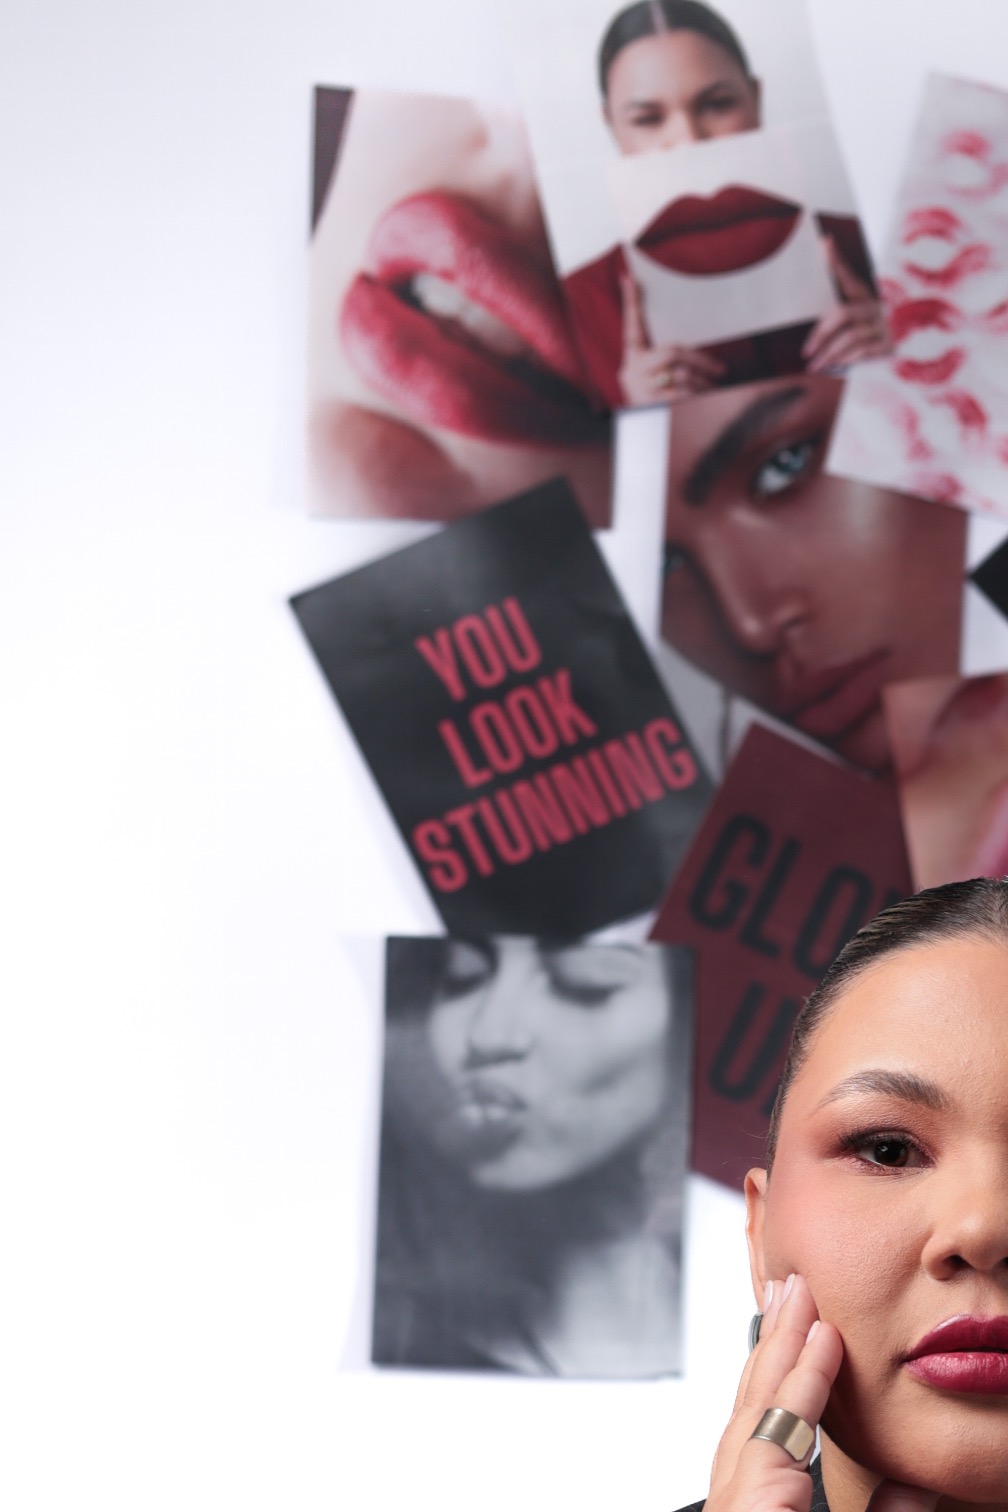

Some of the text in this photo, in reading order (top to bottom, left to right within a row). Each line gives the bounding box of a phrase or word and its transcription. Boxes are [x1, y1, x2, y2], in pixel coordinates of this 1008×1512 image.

[415, 596, 541, 701] YOU
[438, 668, 597, 788] LOOK
[412, 717, 697, 893] STUNNING
[687, 812, 902, 981] GLO
[708, 982, 800, 1117] U
